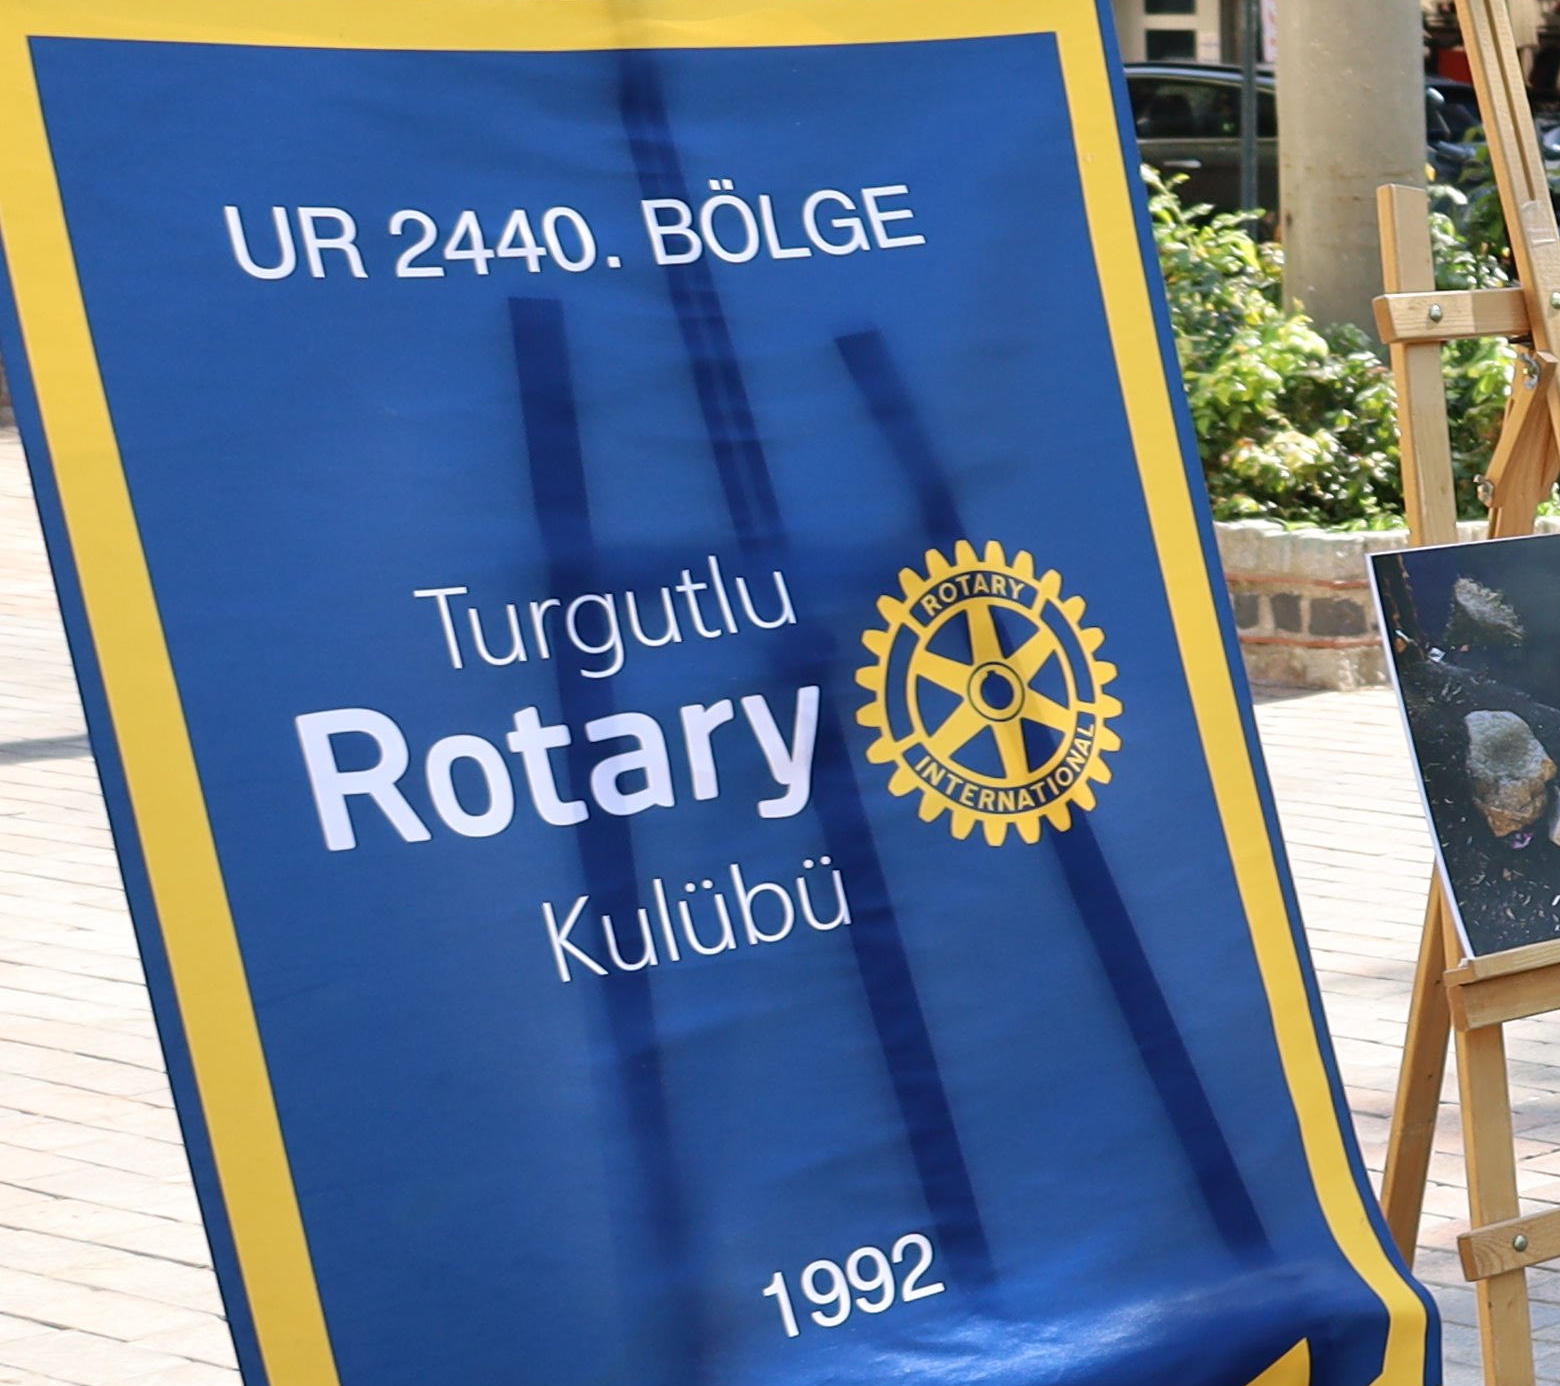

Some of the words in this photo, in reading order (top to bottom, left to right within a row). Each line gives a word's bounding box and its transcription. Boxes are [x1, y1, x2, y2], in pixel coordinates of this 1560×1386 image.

[224, 204, 368, 281] UR
[389, 205, 622, 279] 2440.
[641, 179, 926, 266] BÖLGE
[413, 555, 797, 679] Turgutlu
[919, 572, 1026, 617] ROTARY
[294, 684, 821, 852] Rotary
[914, 723, 1095, 812] INTERNATIONAL
[542, 855, 852, 983] Kulübü
[762, 1232, 946, 1338] 1992
